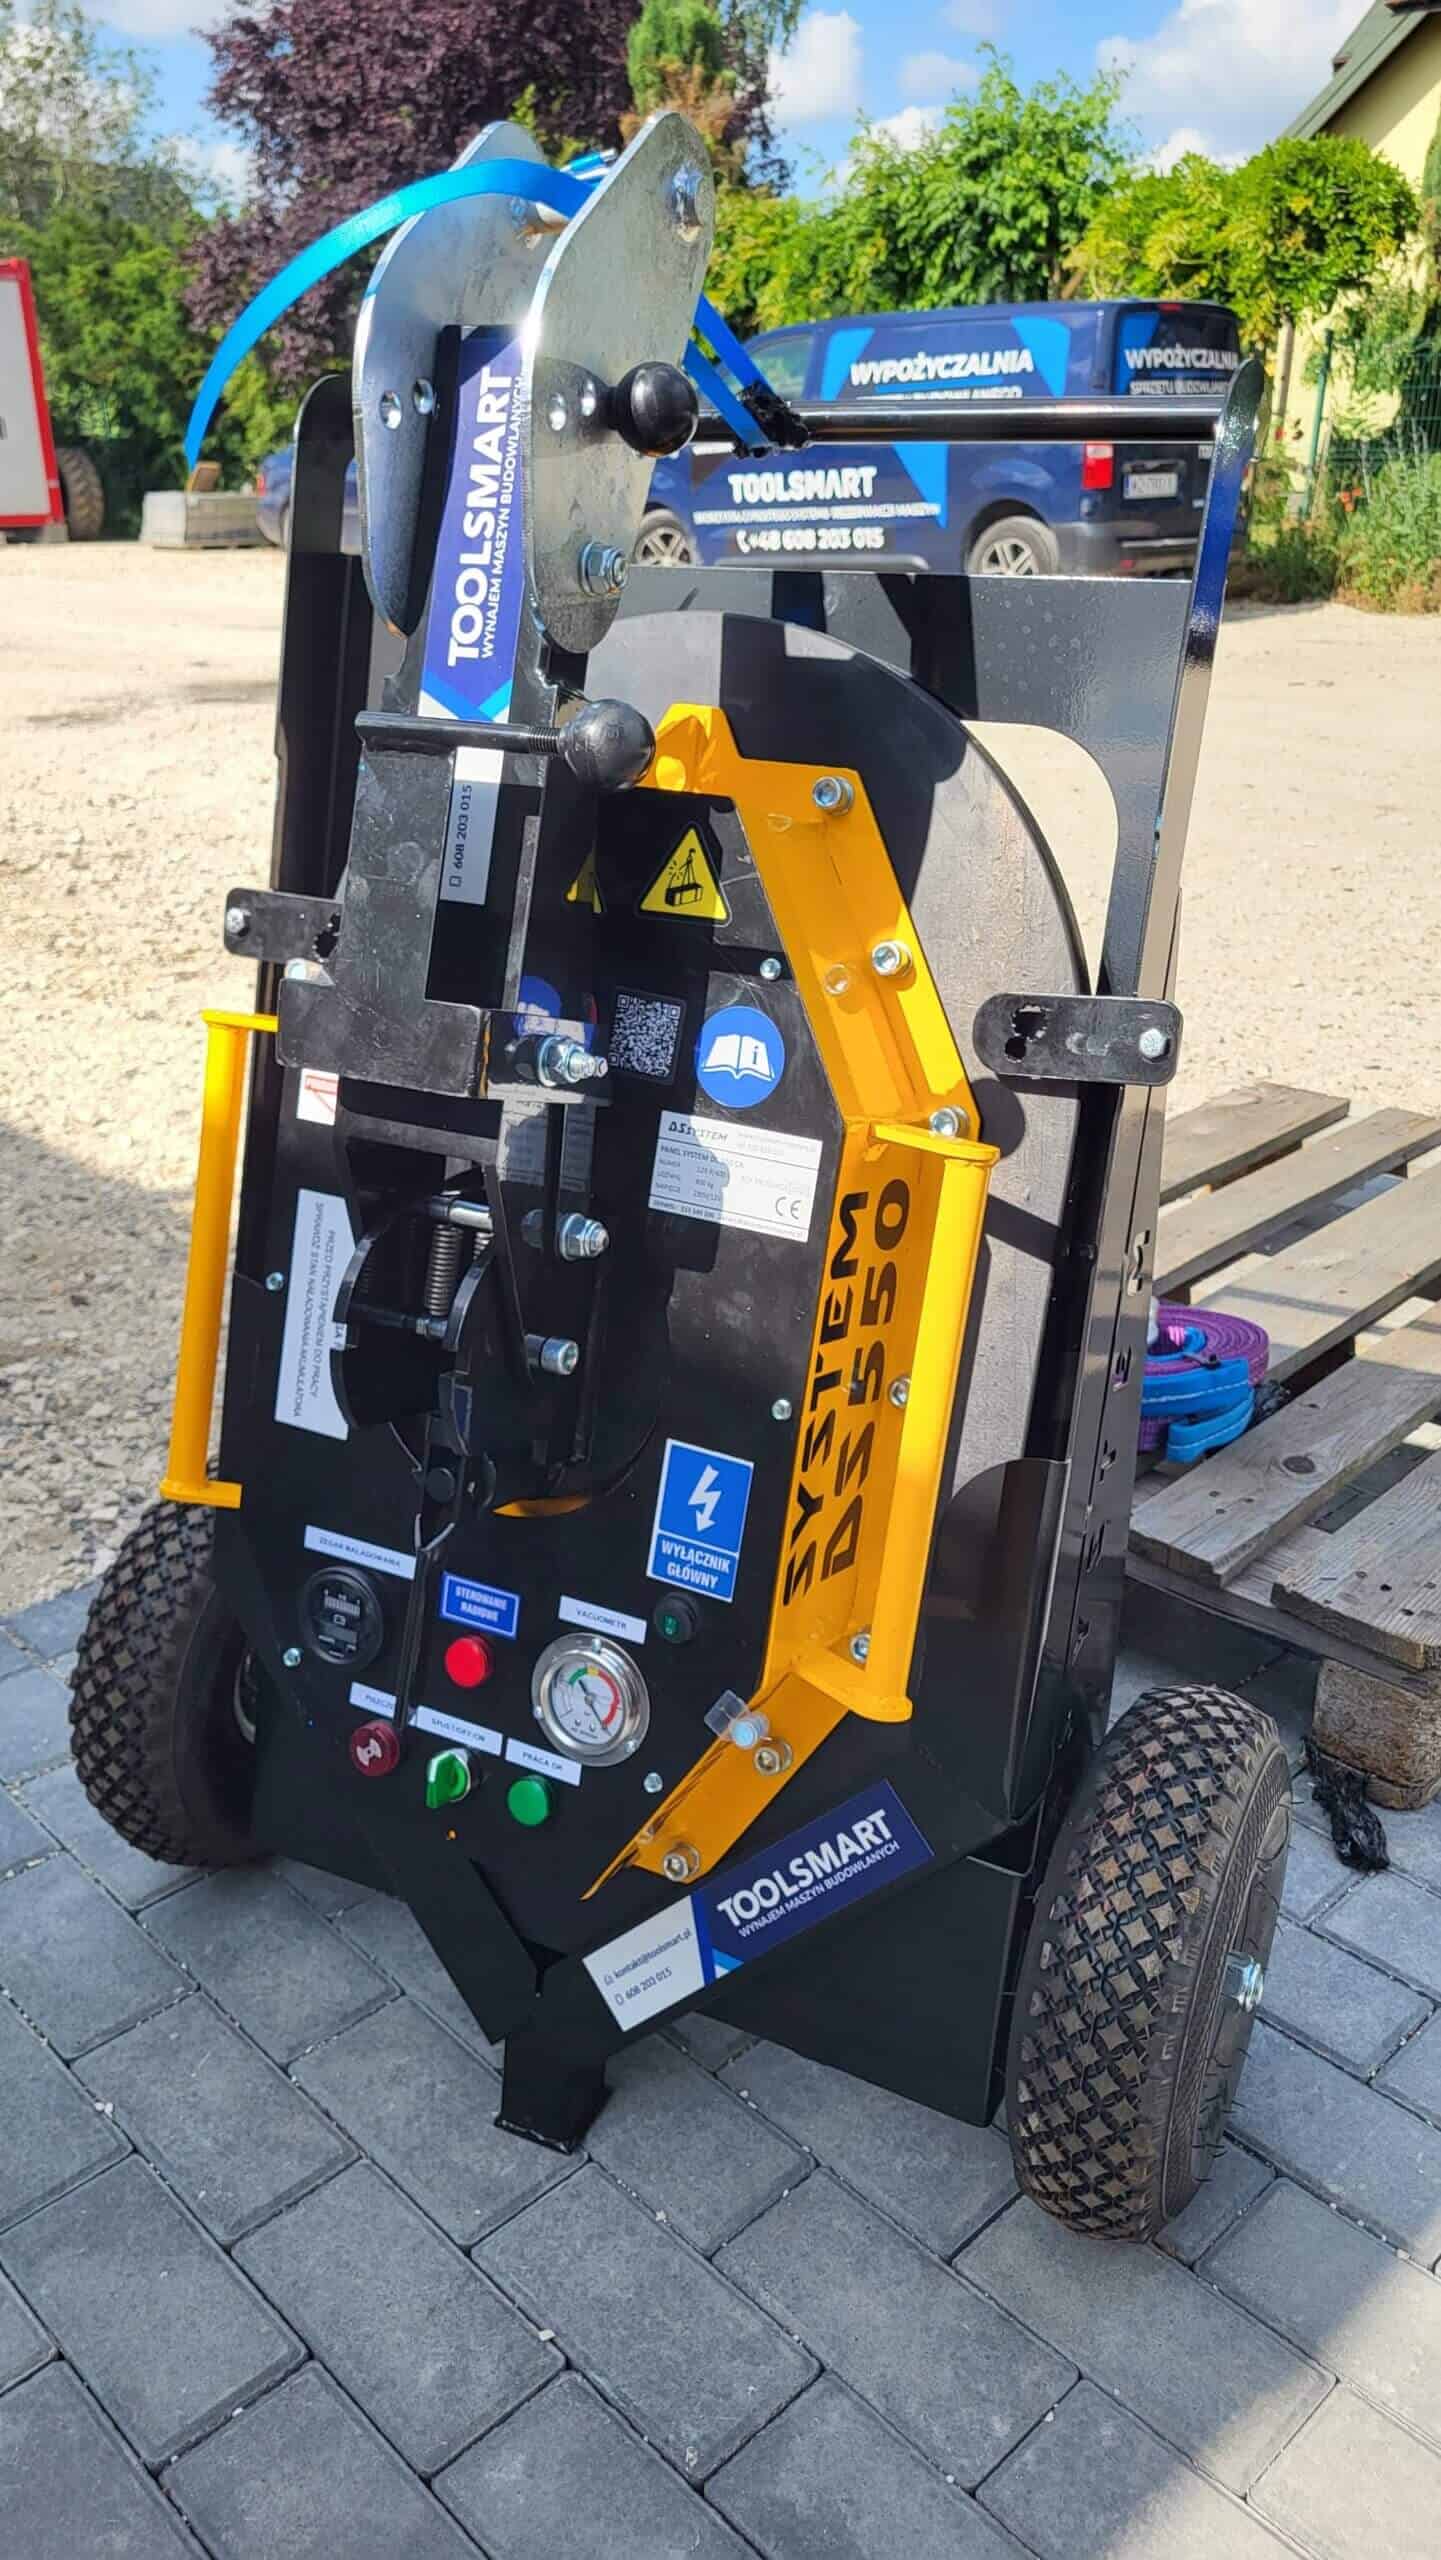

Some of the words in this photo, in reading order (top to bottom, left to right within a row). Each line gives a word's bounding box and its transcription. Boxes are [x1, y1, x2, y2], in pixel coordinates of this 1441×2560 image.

[850, 349, 1035, 386] WYPOŻYCZALNIA
[500, 375, 523, 505] BUDOWLANYCH
[728, 466, 878, 504] TOOLSMART
[447, 366, 512, 667] TOOLSMART
[492, 507, 511, 575] MASZYN
[481, 578, 502, 659] WYNAJEM
[460, 784, 473, 811] 015
[456, 814, 469, 840] 203
[783, 1191, 869, 1606] SYSTEM
[661, 1539, 731, 1574] WYŁĄCZNIK
[666, 1561, 719, 1589] GŁÓWNY
[716, 1808, 893, 1928] TOOLSMART
[738, 1904, 787, 1938] WYNAJEM
[786, 1883, 825, 1912] MASZYN
[825, 1840, 900, 1890] BUDOWLANYCH
[655, 1966, 673, 1982] 015
